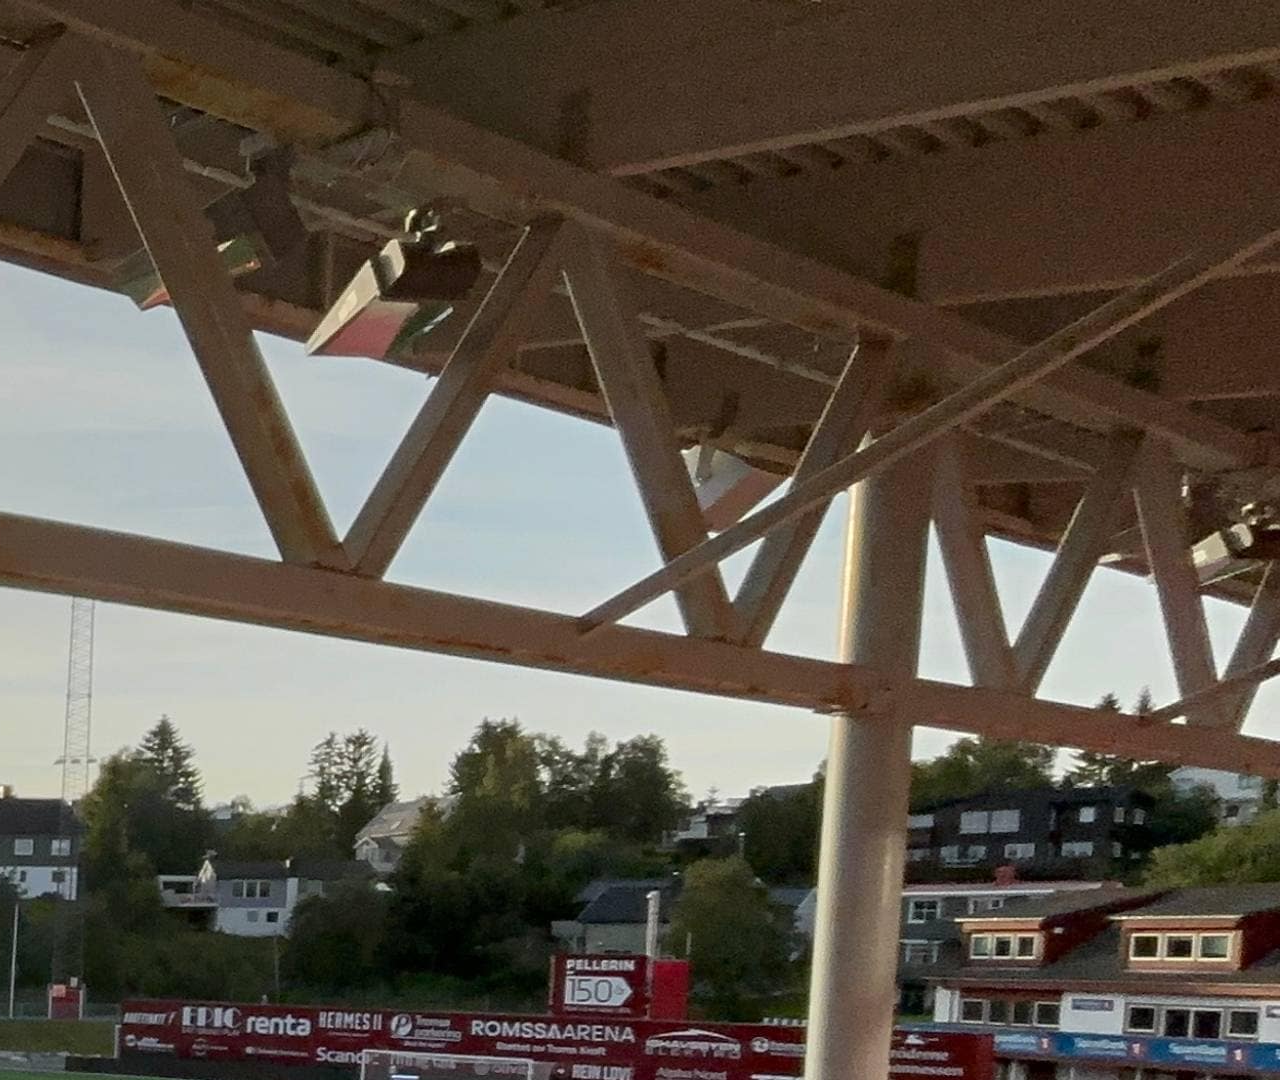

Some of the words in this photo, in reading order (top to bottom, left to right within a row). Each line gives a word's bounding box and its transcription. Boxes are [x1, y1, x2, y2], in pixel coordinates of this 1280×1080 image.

[566, 959, 635, 971] PELLERIN
[568, 977, 613, 1003] 150
[181, 1006, 242, 1028] EPIC
[246, 1010, 311, 1036] renta
[319, 1011, 370, 1030] HERMES
[471, 1020, 636, 1043] ROMSSAARENA
